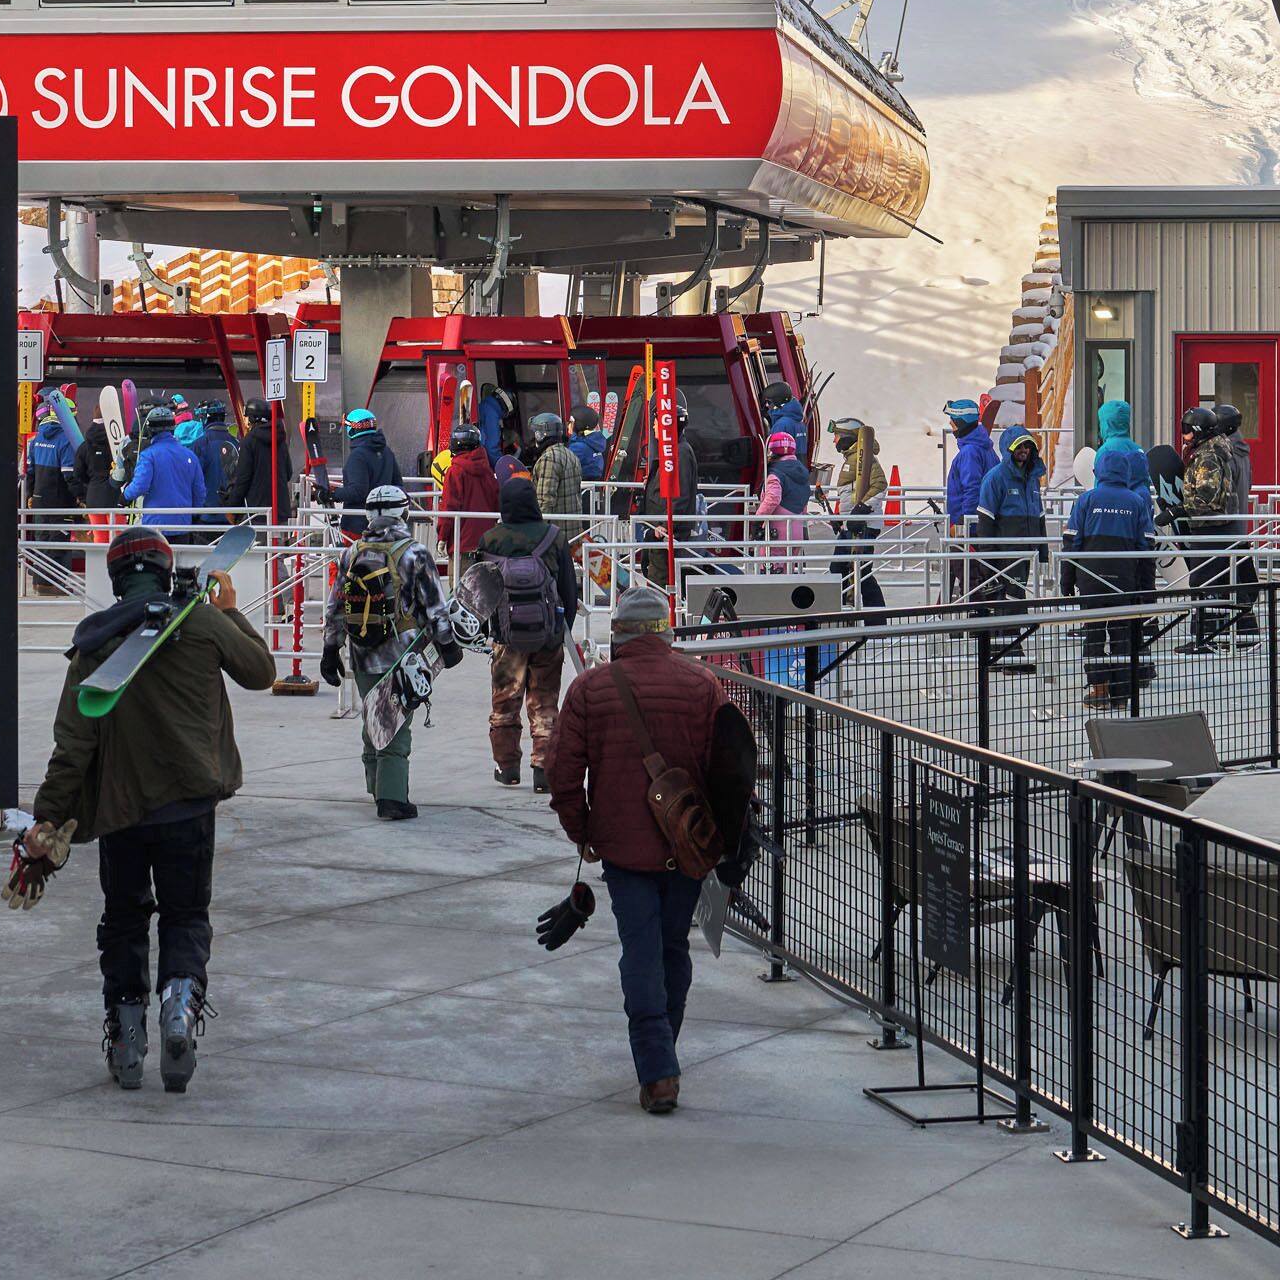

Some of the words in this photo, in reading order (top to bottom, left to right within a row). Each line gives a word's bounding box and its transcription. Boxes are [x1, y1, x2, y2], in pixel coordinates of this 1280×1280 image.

[32, 66, 317, 129] SUNRISE
[341, 62, 731, 127] GONDOLA
[23, 355, 28, 369] 1
[305, 355, 315, 370] 2
[273, 383, 280, 394] 10
[660, 367, 675, 472] SINGLES
[929, 798, 961, 825] PENDRY
